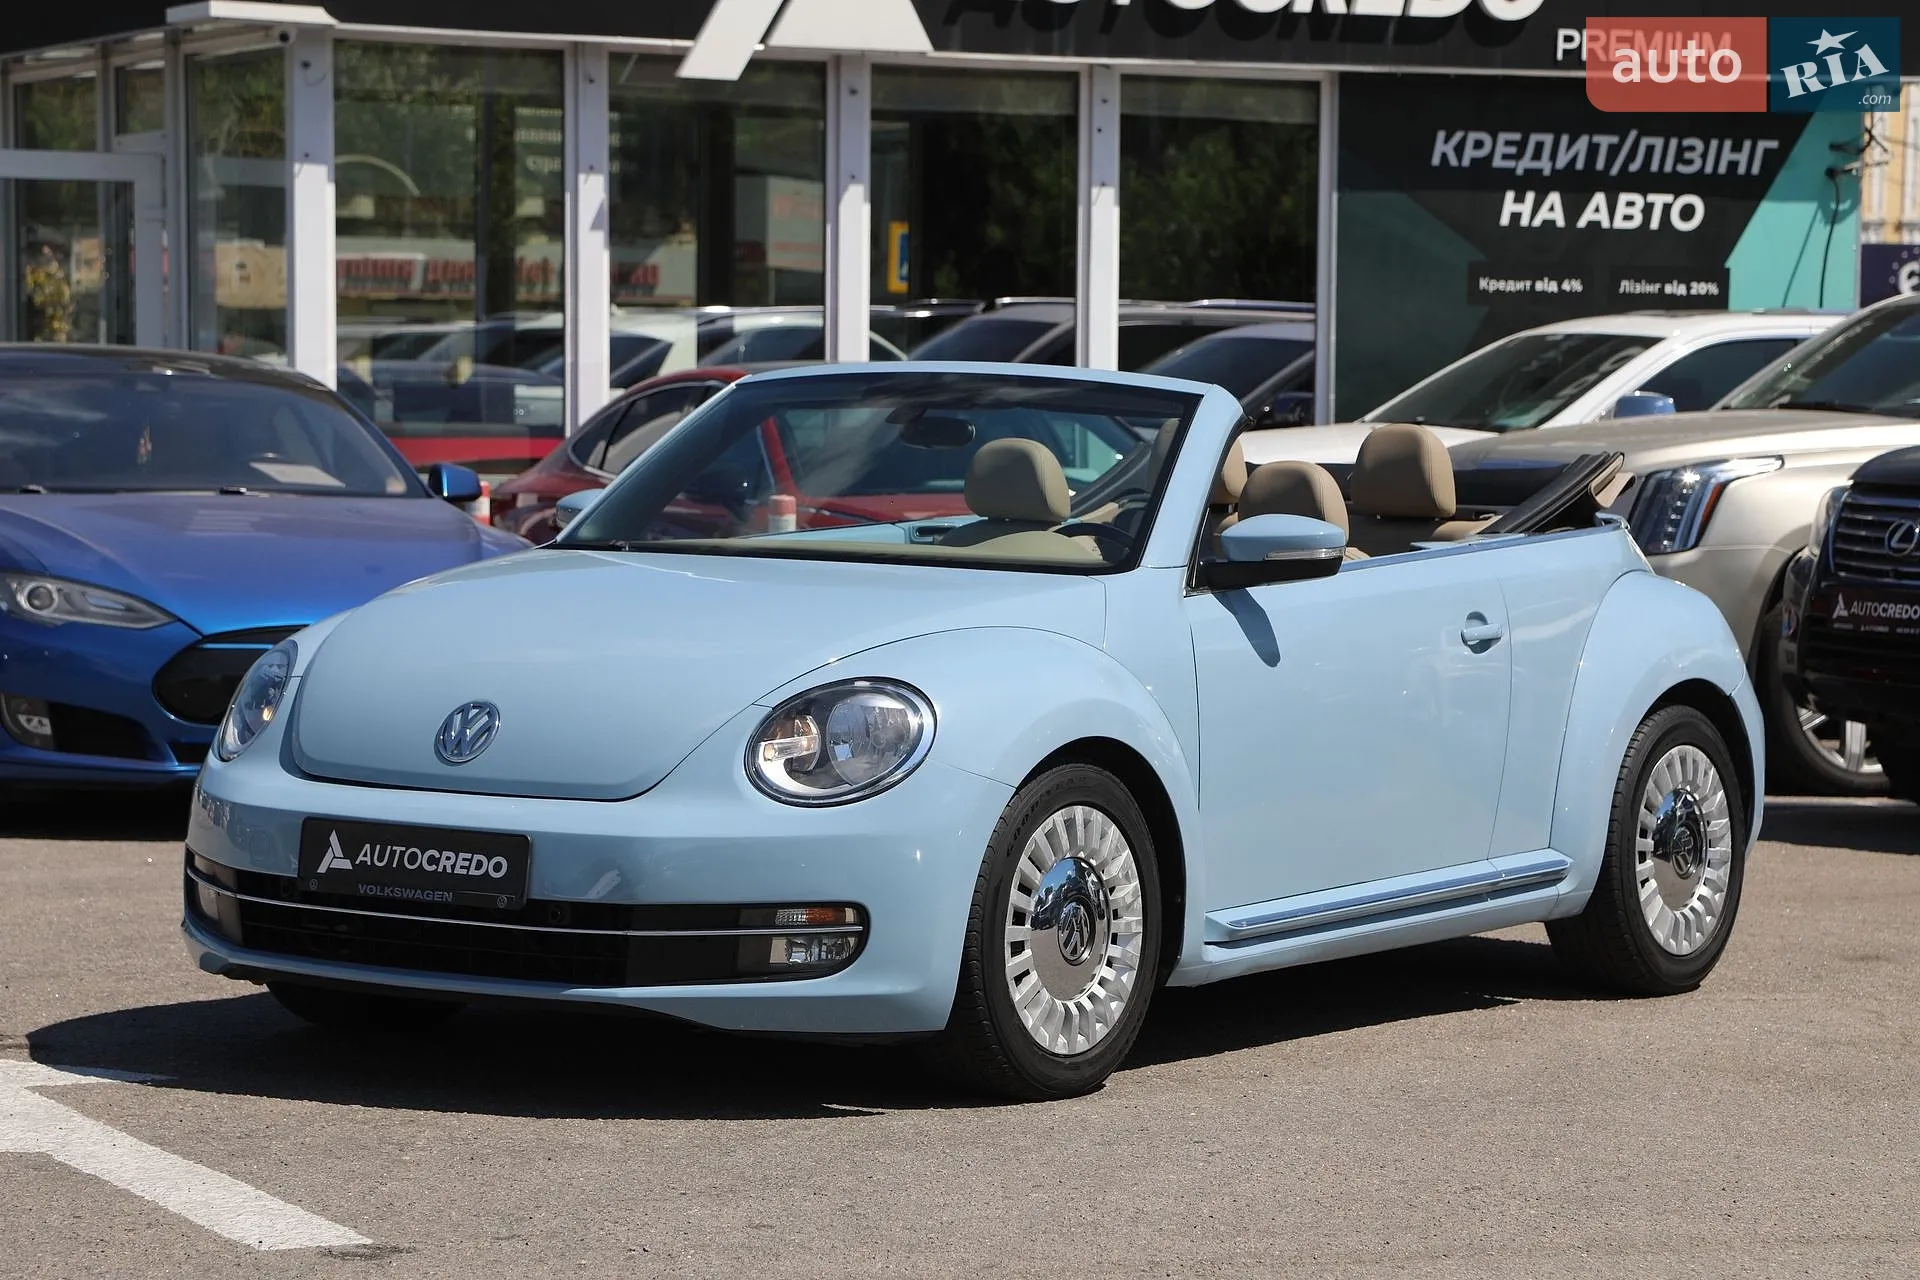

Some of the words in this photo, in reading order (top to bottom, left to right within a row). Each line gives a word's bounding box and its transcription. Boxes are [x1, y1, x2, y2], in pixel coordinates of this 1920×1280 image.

[1430, 129, 1780, 177] КРЕДИТ/ЛІЗІНГ
[1498, 190, 1567, 229] НА
[1576, 190, 1706, 233] АВТО
[1478, 276, 1533, 294] Кредит
[1534, 276, 1559, 294] від
[1561, 278, 1584, 293] 4%
[1618, 279, 1662, 294] Лізінг
[1664, 279, 1688, 296] від
[1689, 280, 1720, 296] 20%
[1849, 600, 1920, 620] AUTOCREDO
[355, 843, 509, 879] AUTOCREDO
[358, 883, 454, 903] VOLKSWAGEN
